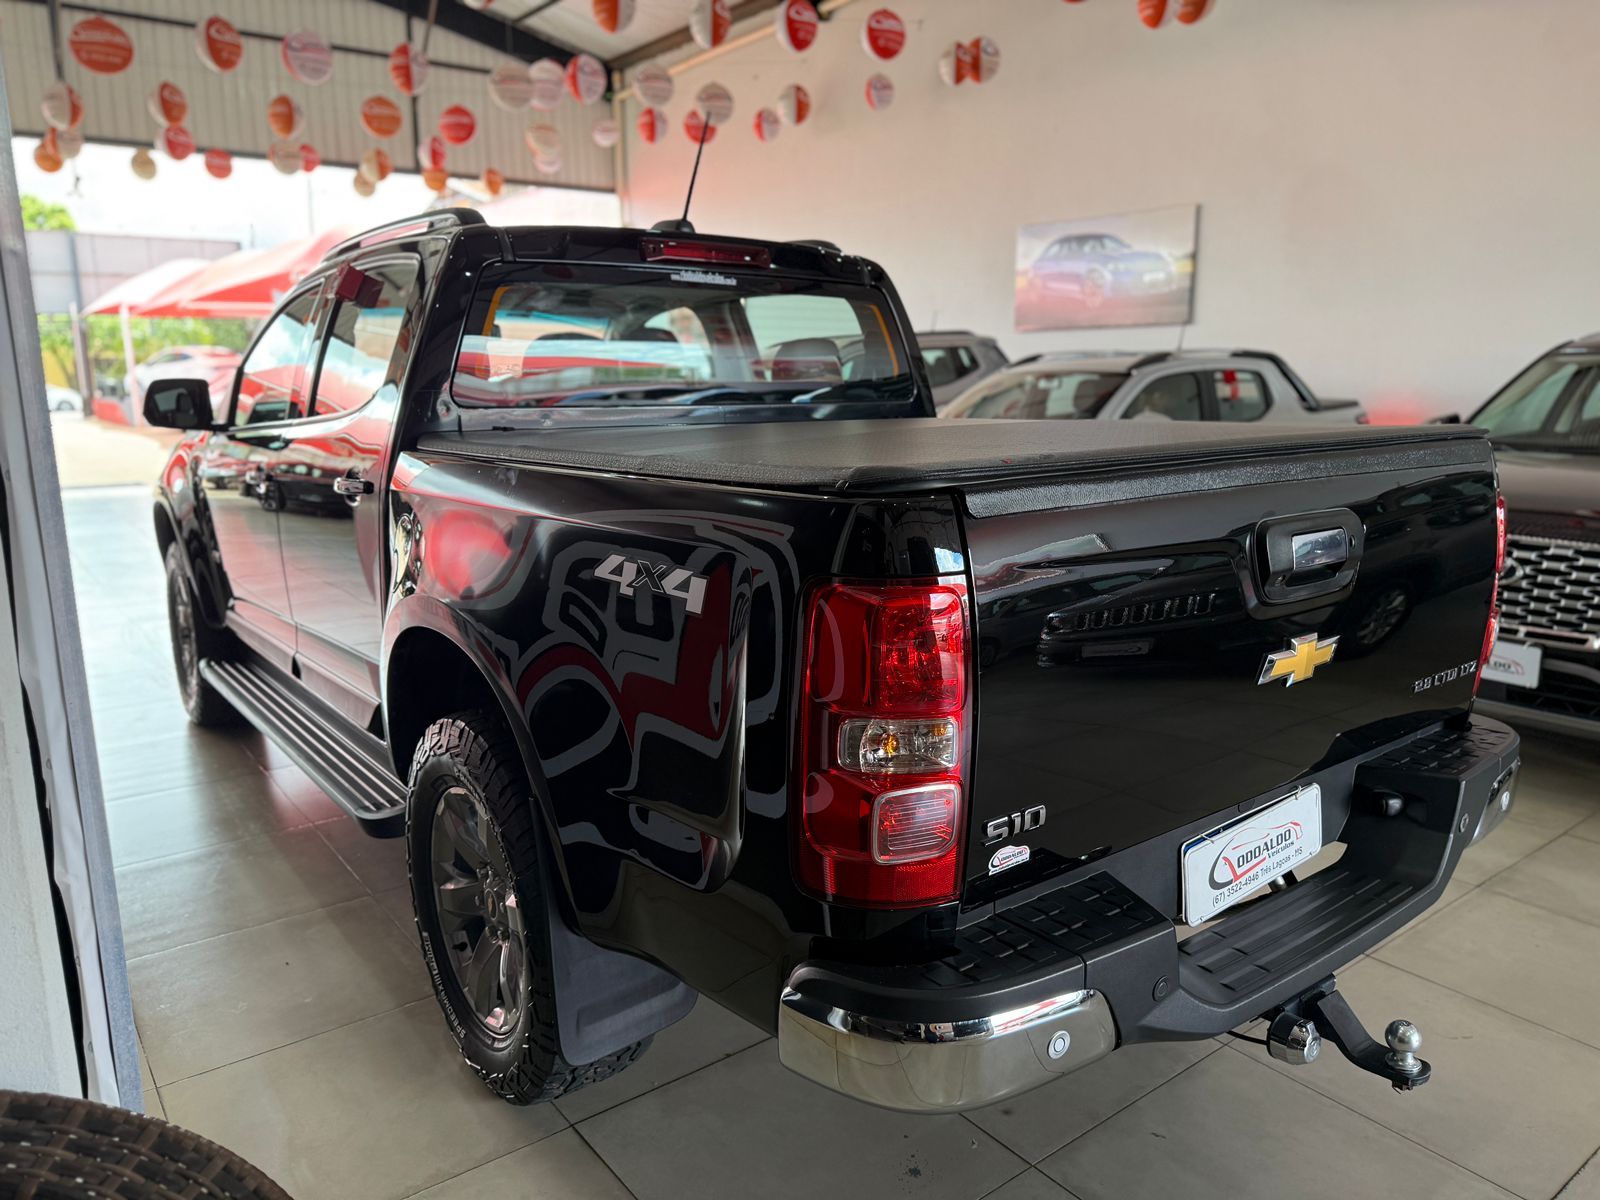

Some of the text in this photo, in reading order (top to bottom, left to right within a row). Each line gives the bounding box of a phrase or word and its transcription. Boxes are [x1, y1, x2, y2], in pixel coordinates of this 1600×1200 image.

[985, 804, 1047, 847] S10
[1212, 891, 1226, 908] (67)
[1227, 871, 1260, 898] 3522-4946
[1294, 846, 1304, 858] MS
